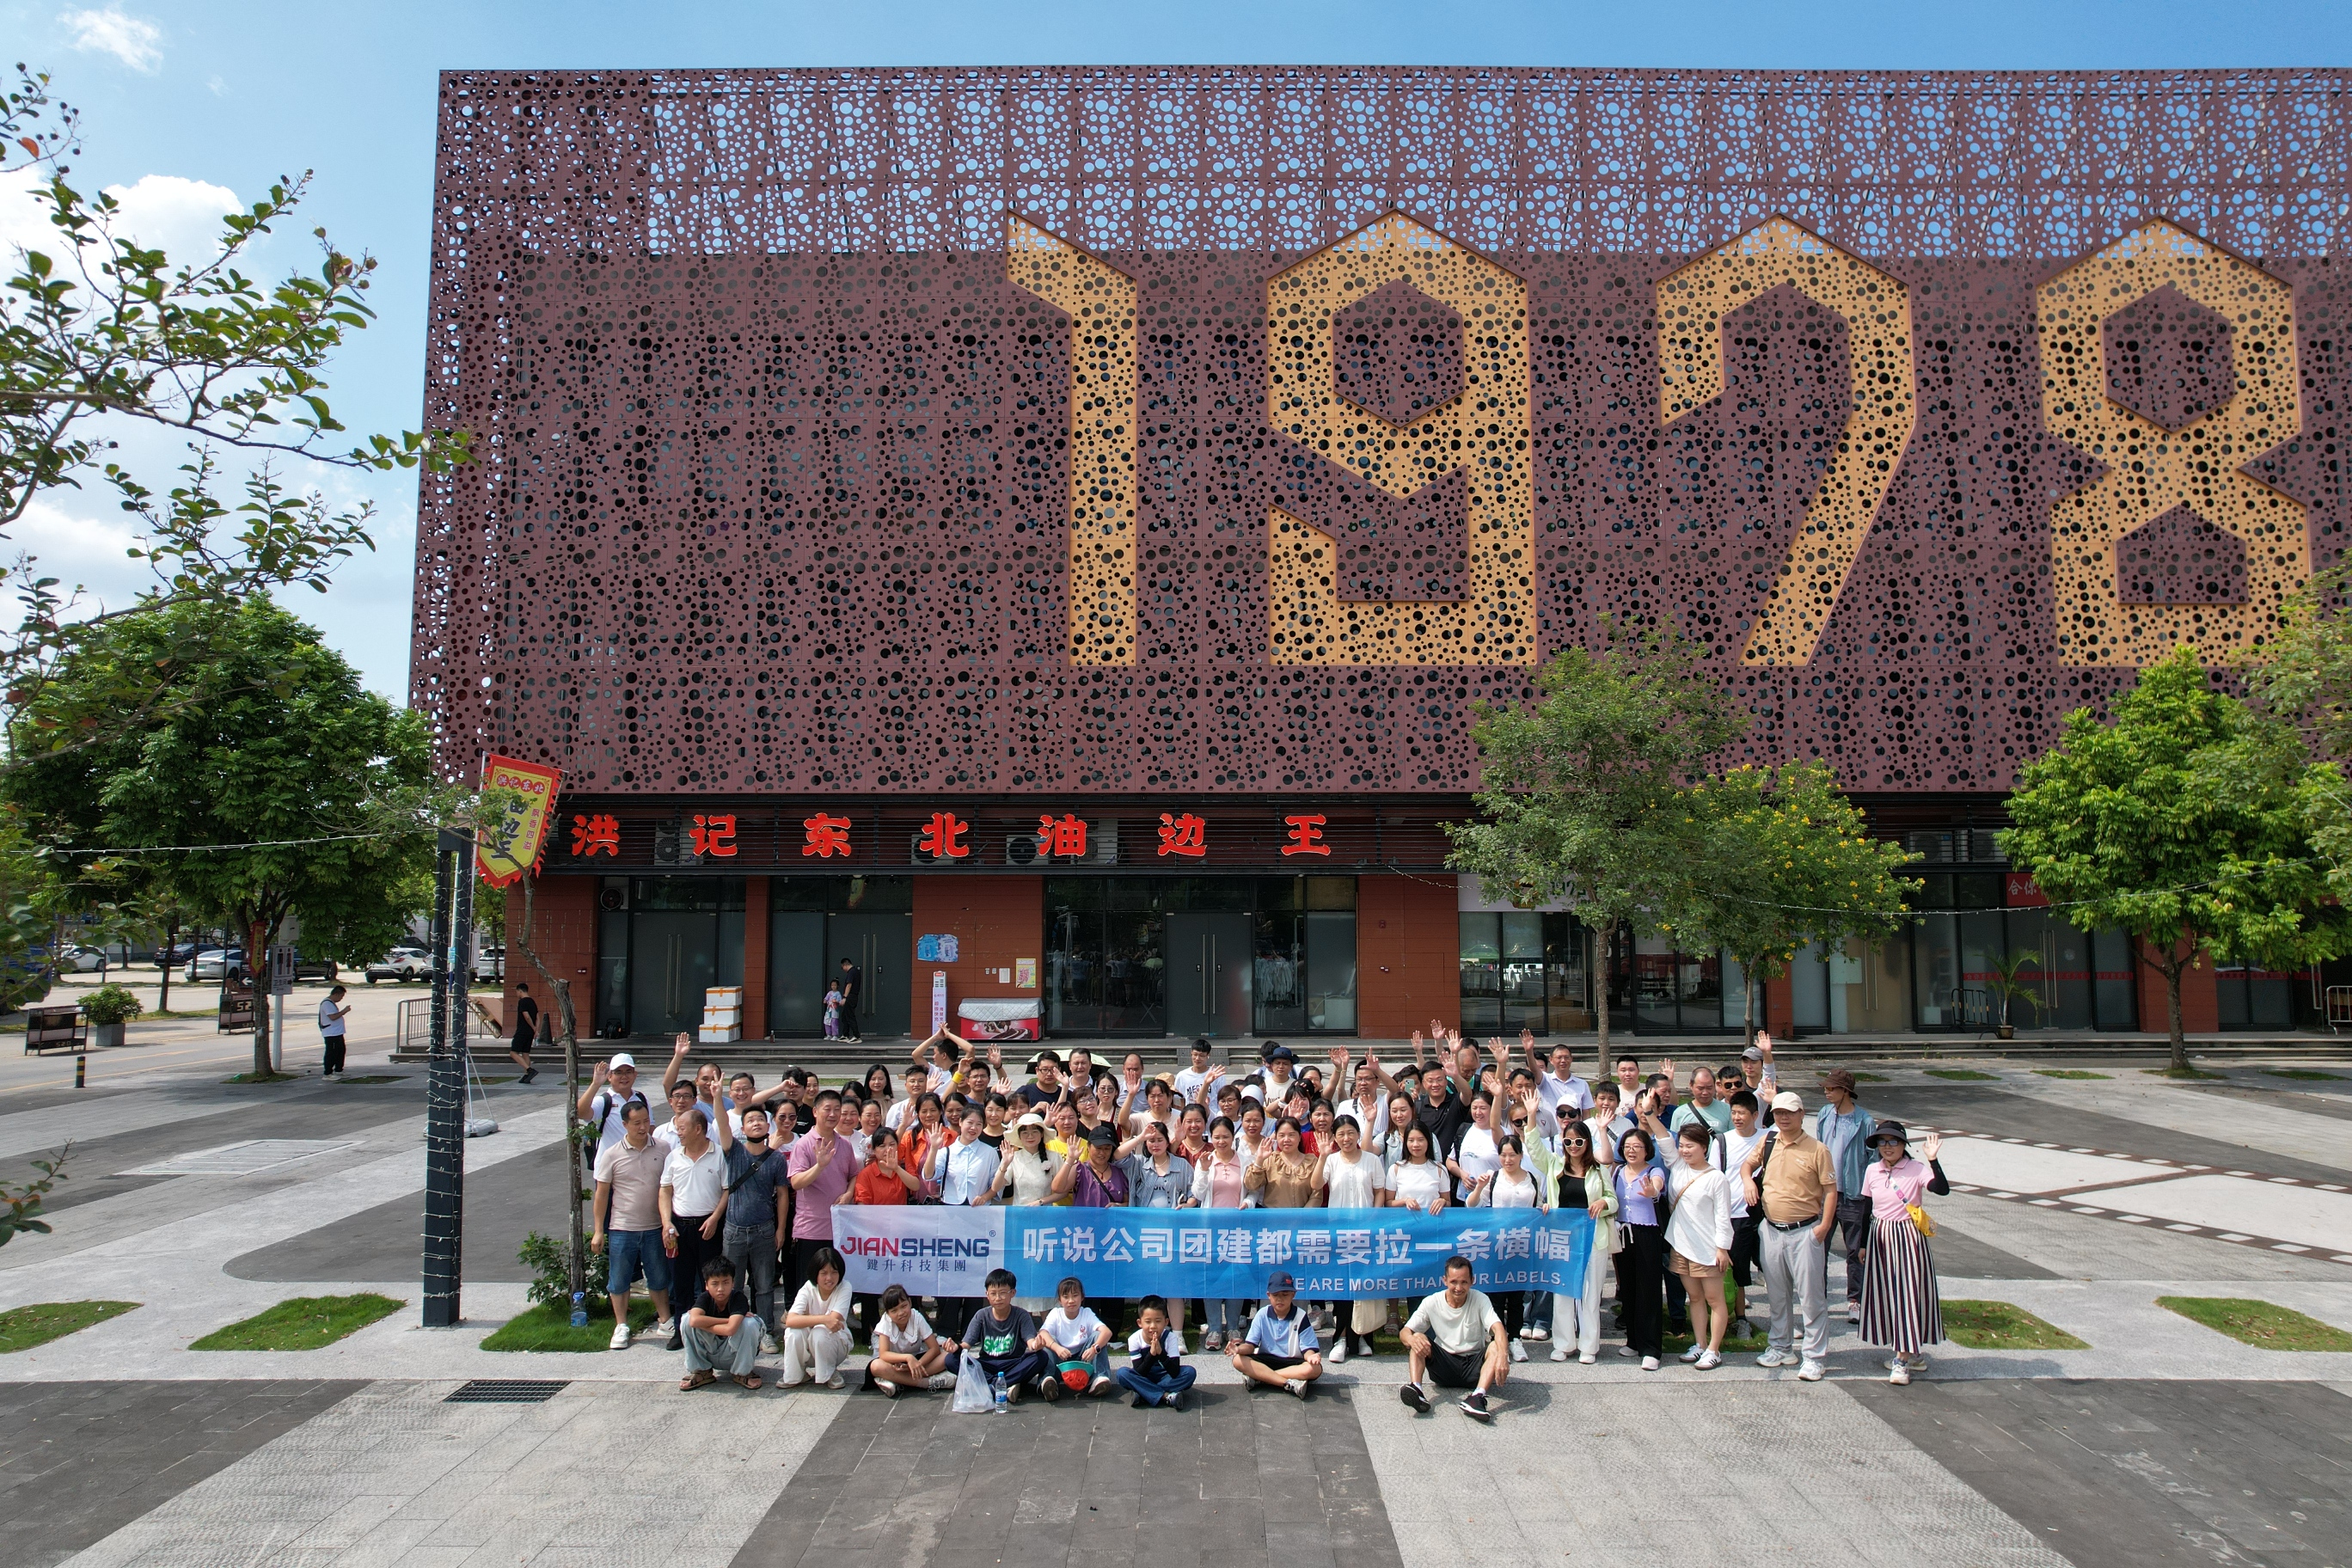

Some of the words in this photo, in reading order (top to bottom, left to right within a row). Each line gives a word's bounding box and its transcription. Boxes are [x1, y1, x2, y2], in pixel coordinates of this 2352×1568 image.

[1008, 210, 2313, 668] 1978
[497, 775, 545, 794] 洪记东北
[570, 812, 1332, 859] 洪记东北油边王
[2008, 879, 2043, 897] 合你
[840, 1236, 990, 1258] JIANSHENG
[1022, 1226, 1571, 1265] 听说公司团建都需要拉一条横幅
[867, 1259, 966, 1272] 鍵升科技集團
[1292, 1277, 1305, 1290] E
[1308, 1277, 1344, 1291] ARE
[1349, 1277, 1399, 1291] MORE
[1494, 1271, 1566, 1288] LABELS.
